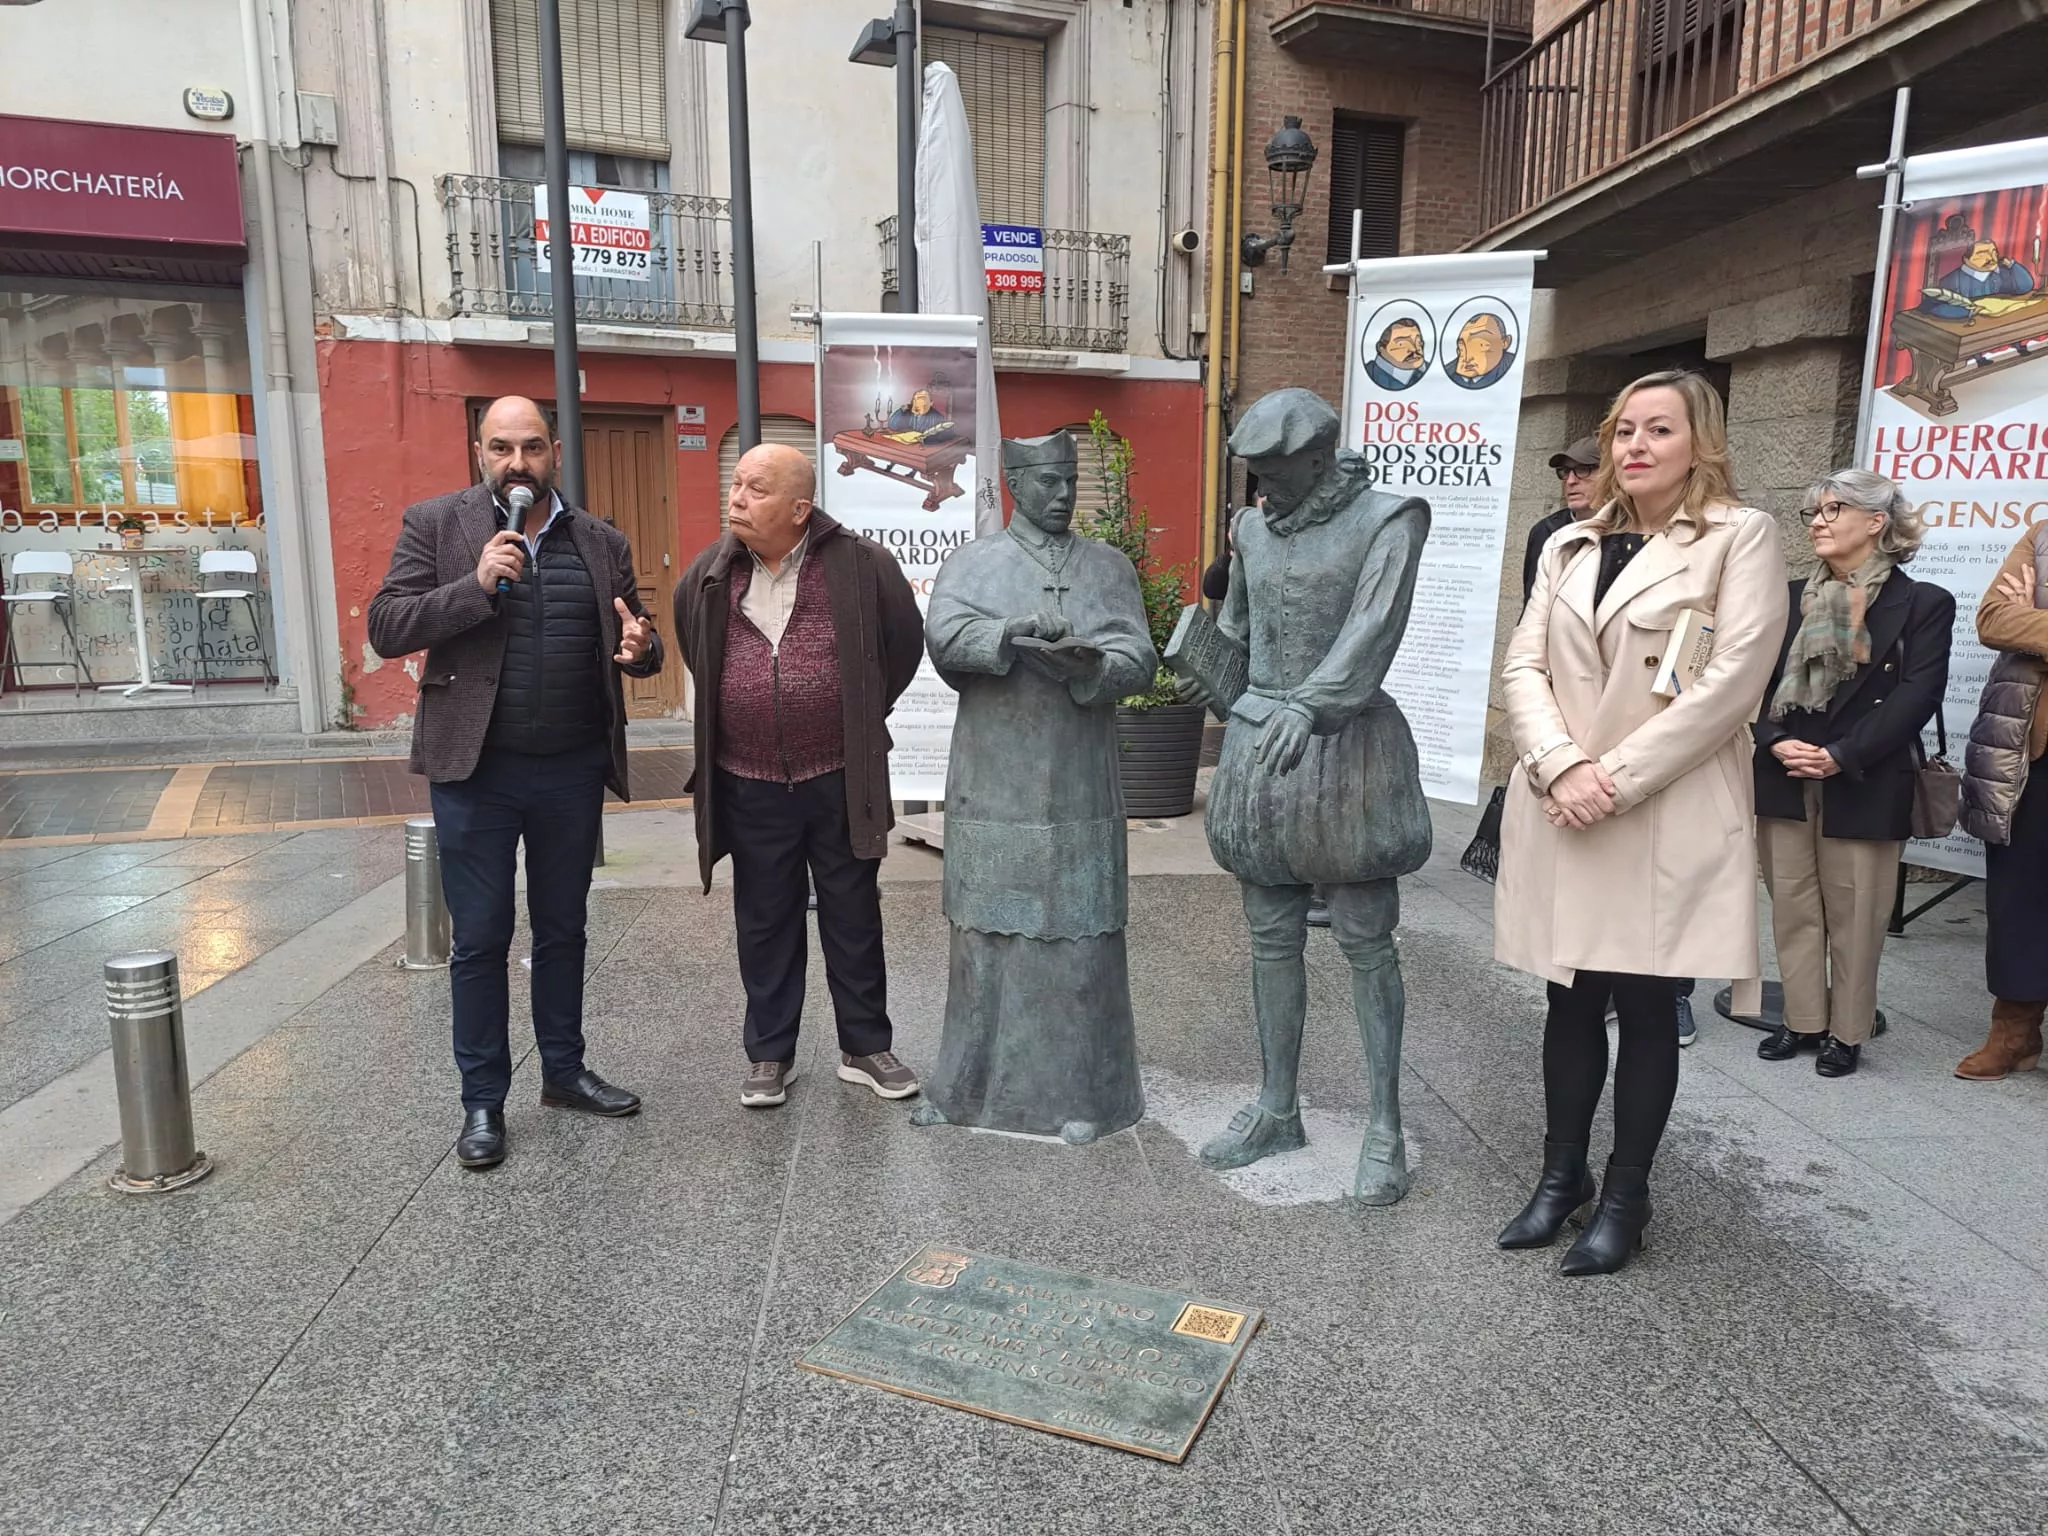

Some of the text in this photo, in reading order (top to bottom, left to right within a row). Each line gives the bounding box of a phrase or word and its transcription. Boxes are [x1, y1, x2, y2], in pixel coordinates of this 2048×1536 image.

[0, 166, 184, 200] ORCHATERÍA
[601, 207, 636, 219] HOME
[542, 222, 646, 248] VTA EDIFICIO
[993, 230, 1037, 244] VENDE
[580, 247, 611, 265] 779
[616, 251, 647, 268] 873
[984, 252, 1039, 263] PRADOSOL
[994, 273, 1018, 287] 308
[1020, 275, 1042, 288] 995
[1364, 401, 1419, 422] DOS
[1363, 422, 1487, 445] LUCEROS,
[1363, 443, 1502, 466] DOS SOLES
[1402, 465, 1491, 487] POESIA
[1921, 542, 1948, 551] nació
[1981, 544, 2007, 553] 1559
[1930, 554, 1965, 564] estudió
[1985, 556, 1998, 564] las
[1910, 565, 1956, 576] Zaragoza.
[1954, 590, 1977, 599] obra
[983, 1275, 1155, 1321] BARBASTRO
[1009, 1303, 1096, 1328] A SUS
[1082, 1335, 1184, 1368] HIJOS
[916, 1340, 1106, 1394] ARGENSOLA
[1037, 1345, 1056, 1359] Y
[1057, 1351, 1206, 1393] LUPERCIO
[1053, 1409, 1120, 1433] ABRIL
